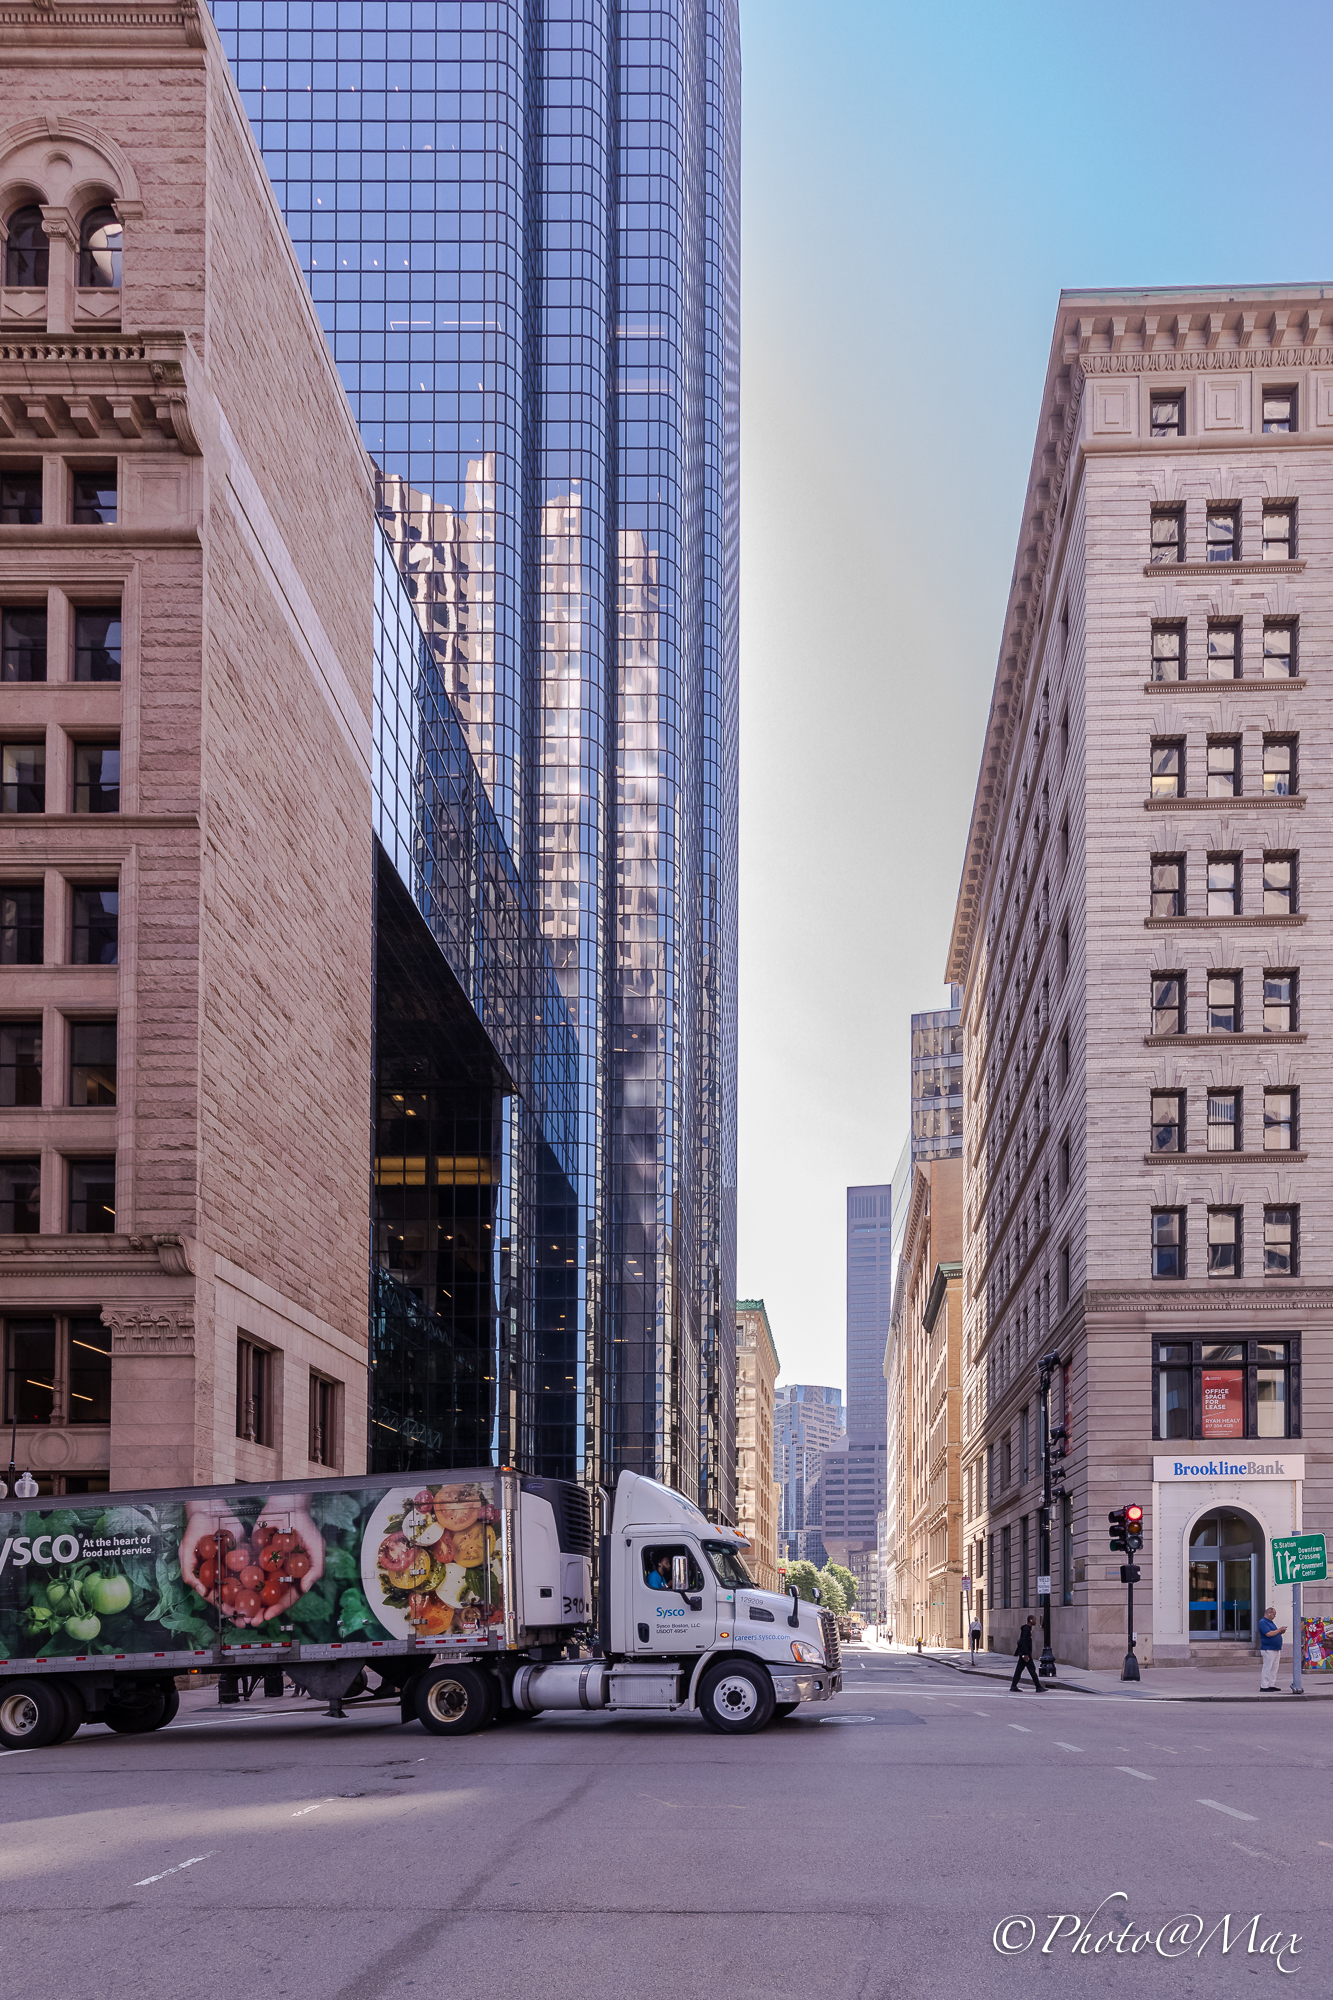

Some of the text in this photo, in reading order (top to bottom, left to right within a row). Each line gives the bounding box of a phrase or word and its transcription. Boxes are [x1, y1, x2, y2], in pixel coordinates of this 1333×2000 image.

[1173, 1460, 1285, 1475] BrooklineBank
[82, 1535, 151, 1548] At the heart of
[1279, 1541, 1297, 1549] Station
[82, 1546, 152, 1558] food and service
[563, 1597, 585, 1614] 390
[656, 1606, 685, 1619] Sysco
[734, 1634, 791, 1642] careers.sysco.com
